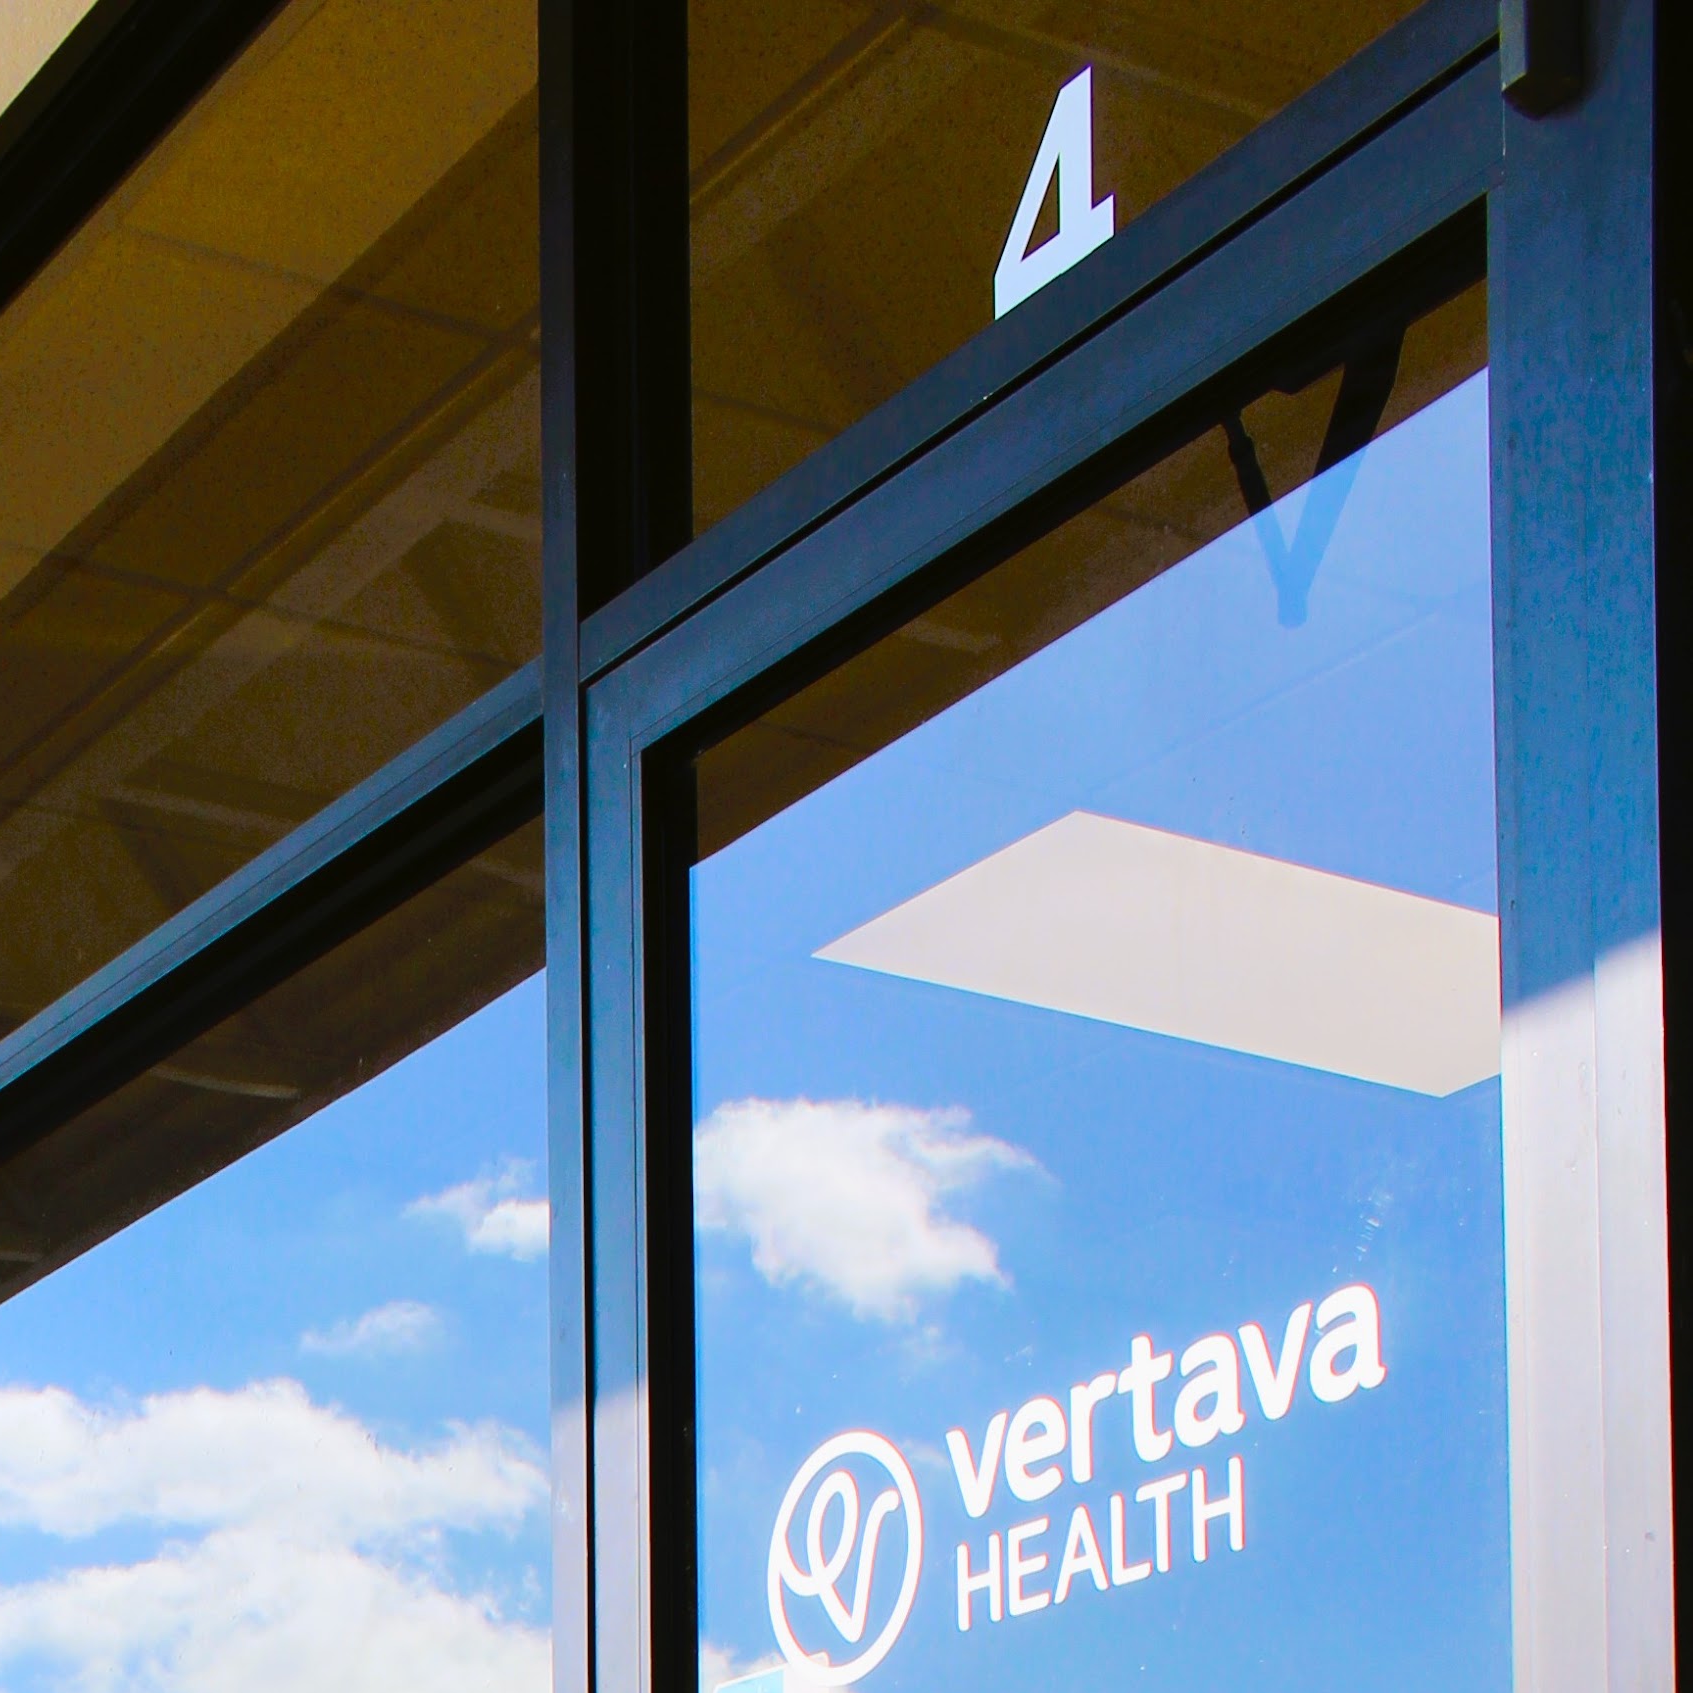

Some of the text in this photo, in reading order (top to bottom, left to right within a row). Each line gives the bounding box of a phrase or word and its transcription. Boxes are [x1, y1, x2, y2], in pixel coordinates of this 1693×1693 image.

[993, 64, 1115, 320] 4
[946, 1282, 1387, 1518] vertava
[956, 1455, 1246, 1632] HEALTH
